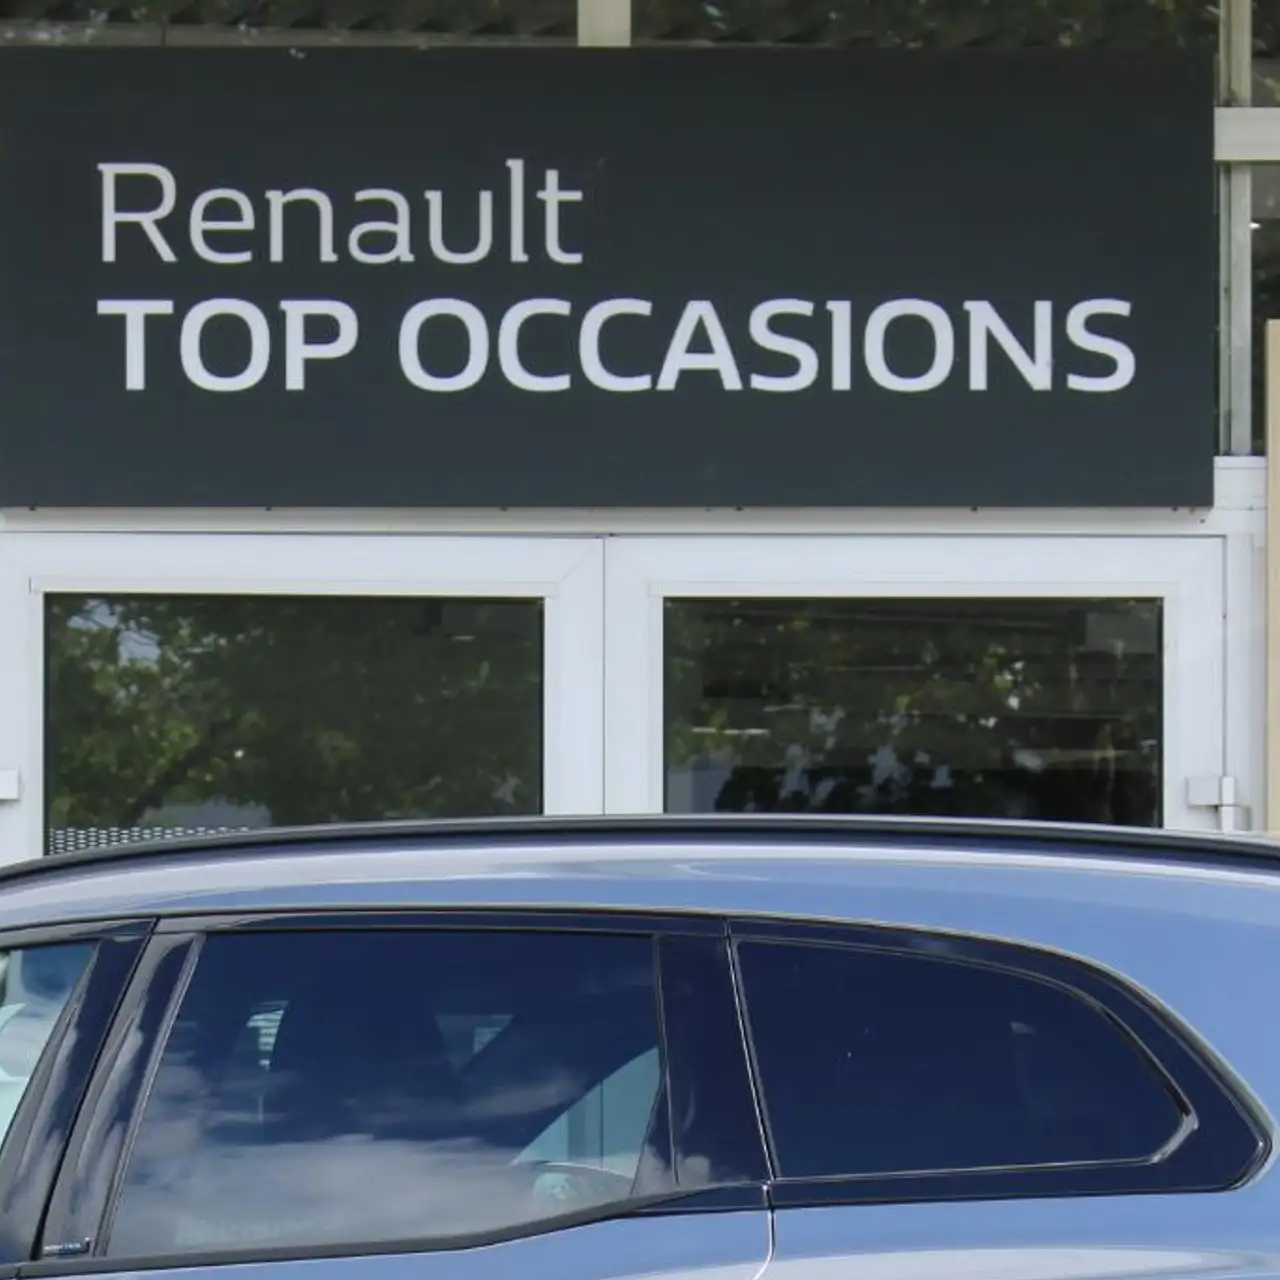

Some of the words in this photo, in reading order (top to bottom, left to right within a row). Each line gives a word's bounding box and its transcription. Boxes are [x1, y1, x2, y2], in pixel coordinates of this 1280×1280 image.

[97, 158, 584, 264] Renault
[97, 297, 360, 393] TOP
[397, 297, 1138, 393] OCCASIONS
